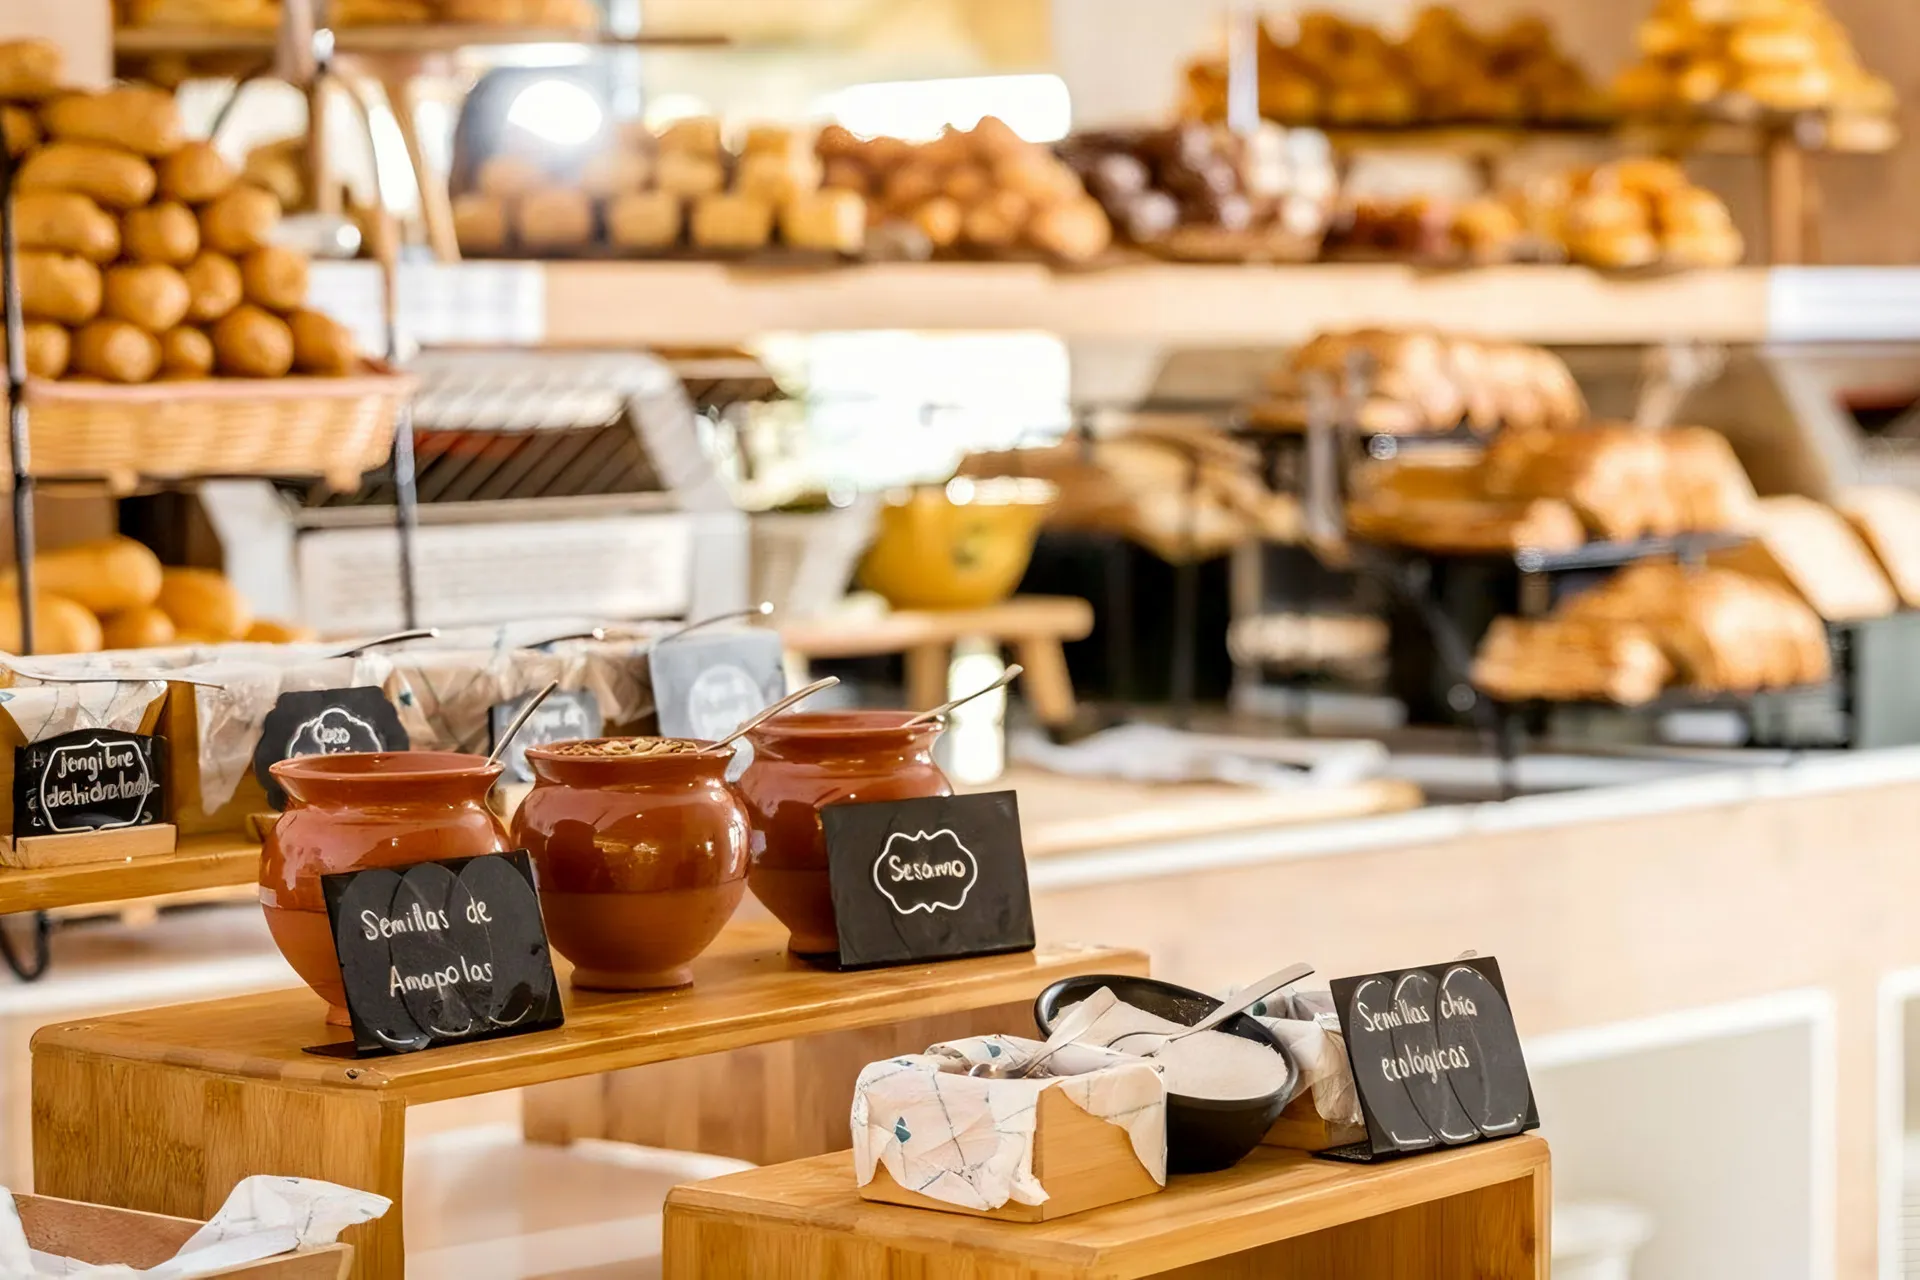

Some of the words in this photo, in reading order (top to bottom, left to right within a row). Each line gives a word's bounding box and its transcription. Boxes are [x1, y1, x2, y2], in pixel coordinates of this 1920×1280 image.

[361, 903, 449, 940] Semillas
[466, 898, 492, 924] de
[390, 956, 493, 998] Amapolas
[1357, 1000, 1430, 1032] Semillas
[1382, 1044, 1470, 1084] ecológicas
